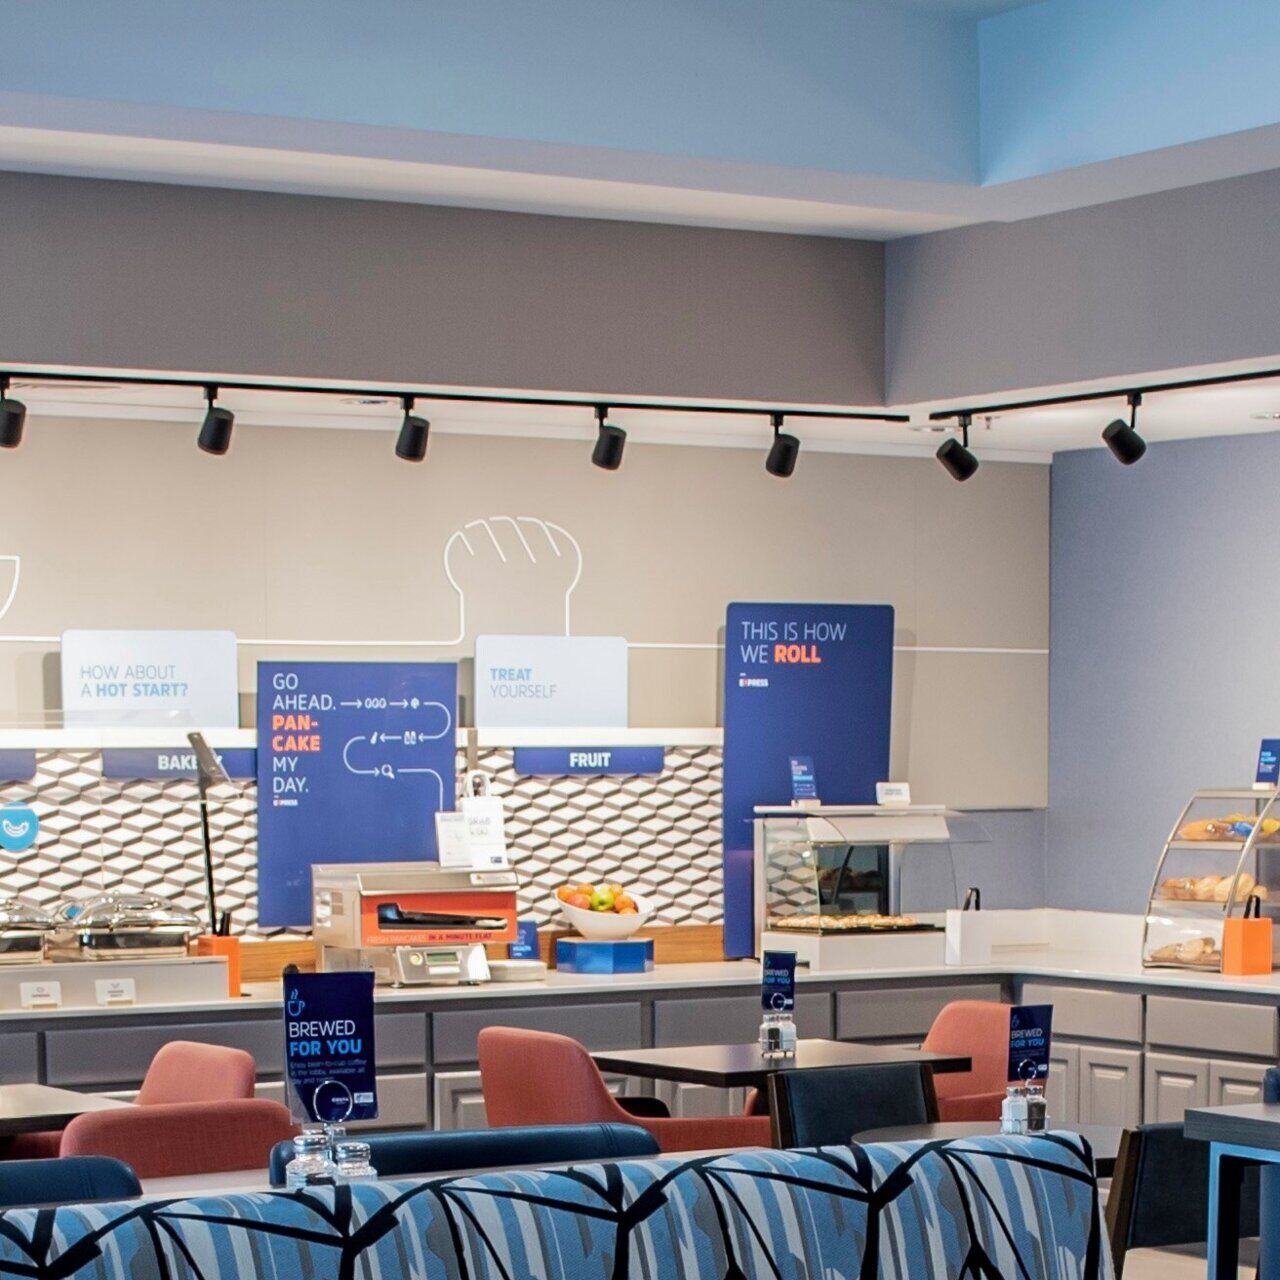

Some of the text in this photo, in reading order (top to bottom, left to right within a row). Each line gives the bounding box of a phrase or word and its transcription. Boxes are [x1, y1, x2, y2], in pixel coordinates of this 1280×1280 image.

[742, 621, 847, 641] THIS IS HOW
[740, 645, 821, 664] WE ROLL
[80, 664, 176, 681] HOW ABOUT
[490, 668, 533, 682] TREAT
[273, 673, 299, 690] GO
[81, 683, 189, 697] A HOT START?
[489, 684, 558, 699] YOURSELF
[273, 694, 337, 711] AHEAD.
[272, 715, 319, 731] PAN-
[272, 735, 320, 751] CAKE
[273, 757, 299, 772] MY
[570, 752, 612, 768] FRUIT
[273, 777, 309, 793] DAY.
[289, 1020, 356, 1037] BREWED
[1011, 1028, 1042, 1039] BREWED
[290, 1039, 362, 1056] FOR YOU
[1028, 1038, 1045, 1046] YOU
